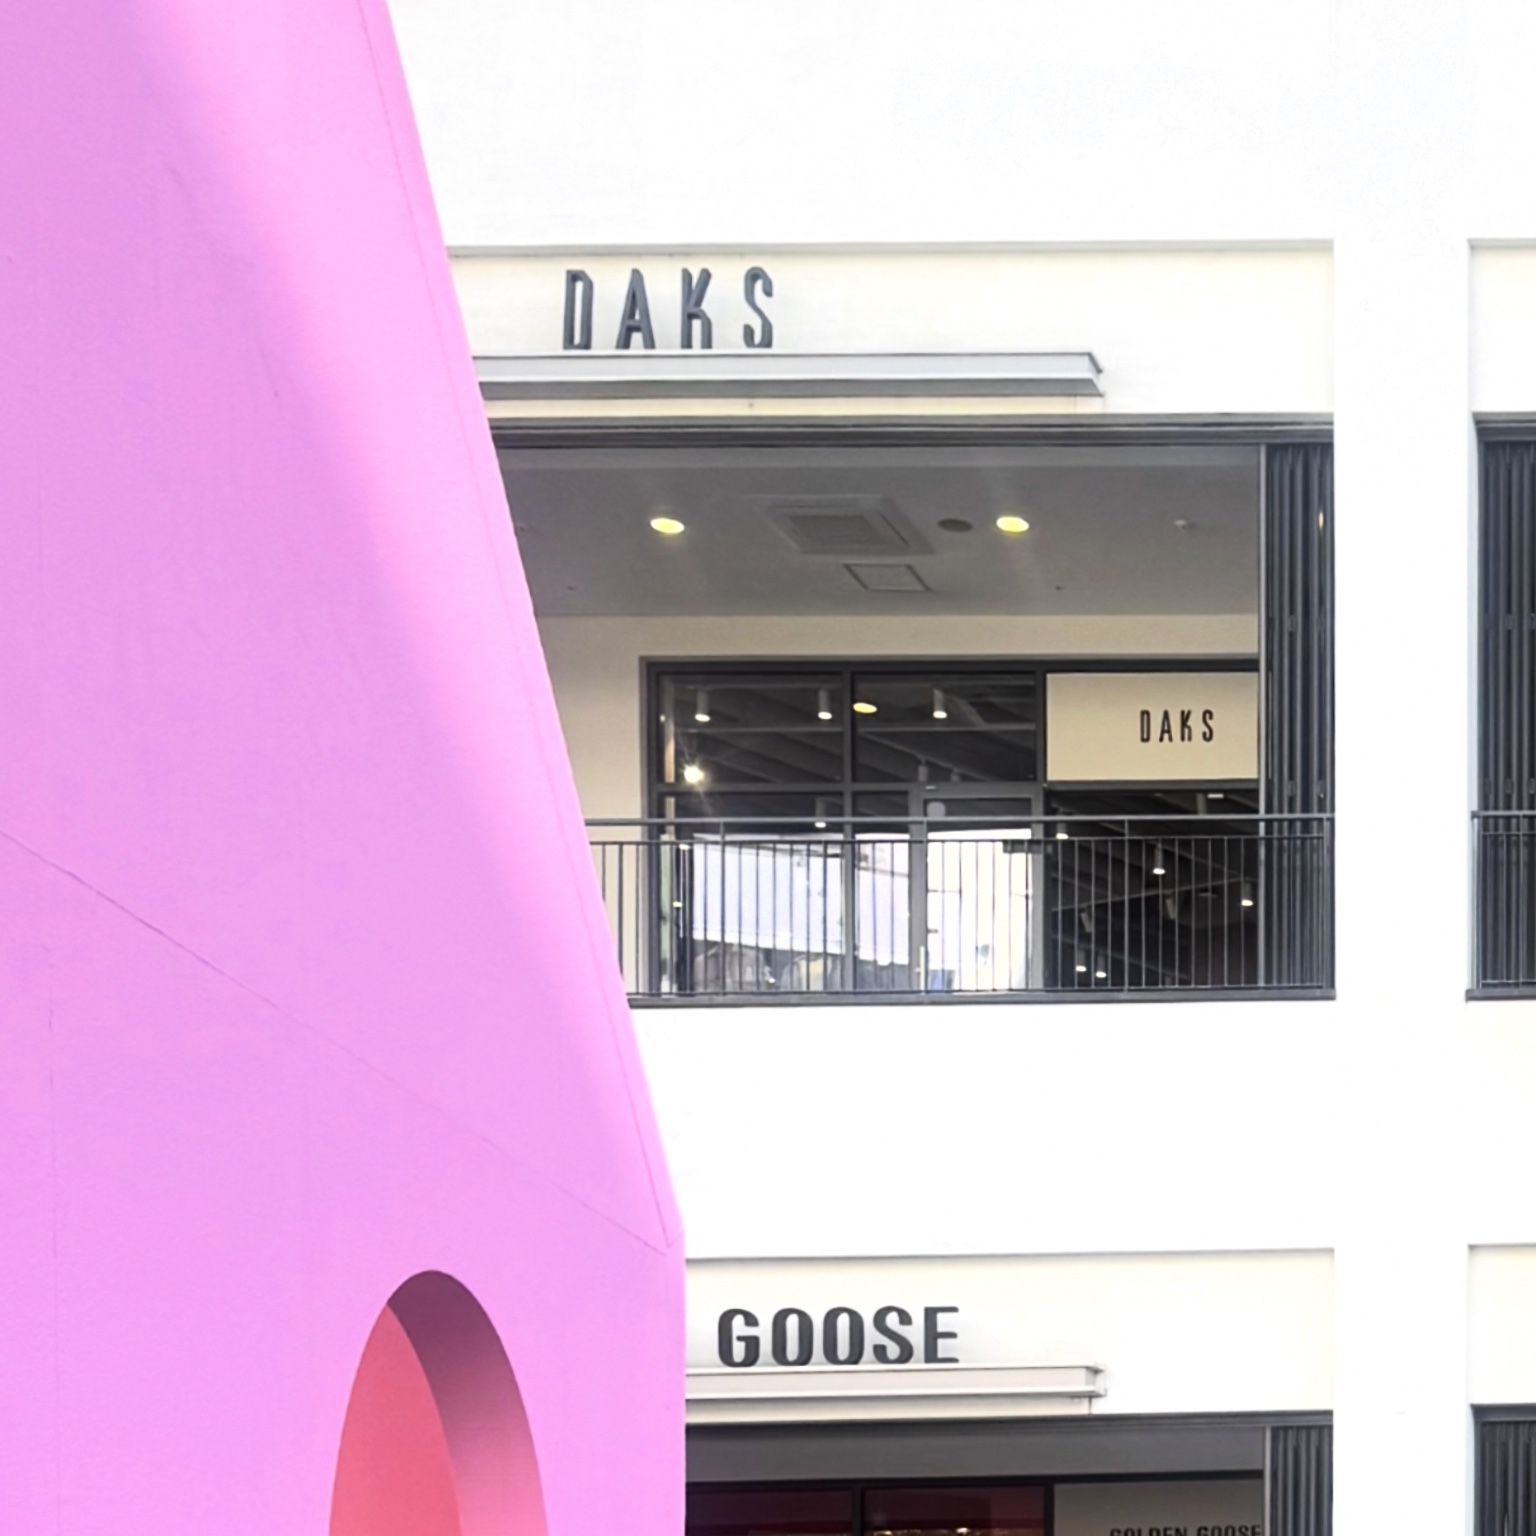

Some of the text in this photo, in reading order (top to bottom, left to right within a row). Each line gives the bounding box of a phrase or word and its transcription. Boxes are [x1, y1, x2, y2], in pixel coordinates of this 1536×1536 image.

[562, 266, 773, 350] DAKS
[1140, 709, 1214, 743] DAKS
[717, 1305, 960, 1368] GOOSE
